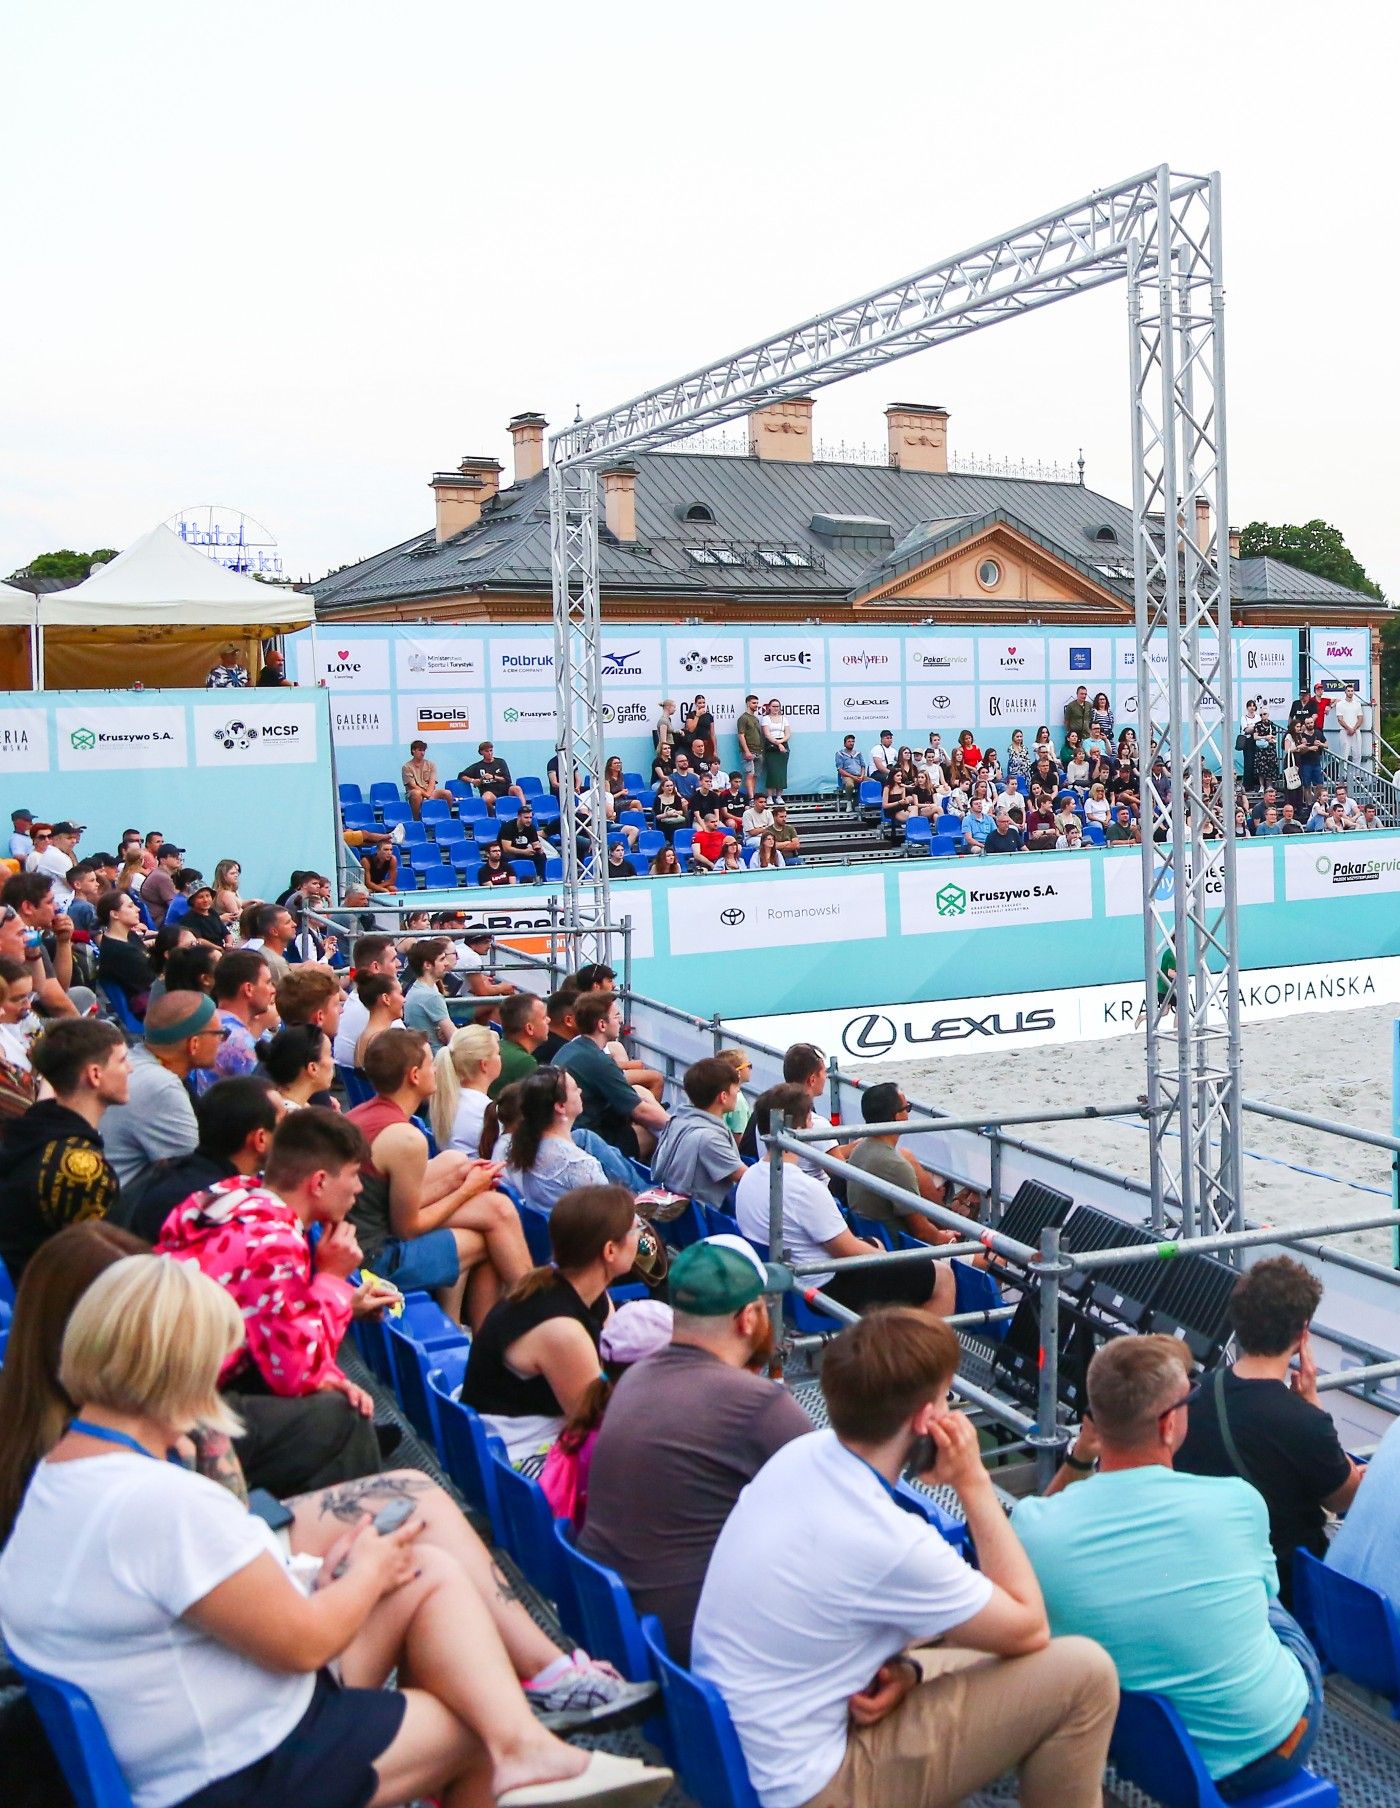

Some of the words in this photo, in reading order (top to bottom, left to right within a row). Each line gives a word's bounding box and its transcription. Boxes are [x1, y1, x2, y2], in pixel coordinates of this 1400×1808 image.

[502, 655, 554, 667] Polbruk
[710, 655, 734, 663] MCSP
[763, 653, 797, 662] arcus
[1260, 653, 1285, 662] GALERIA
[617, 704, 647, 714] caffe
[706, 703, 736, 715] ALERIA
[1006, 698, 1037, 709] GALERIA
[419, 708, 467, 720] Boels
[520, 710, 552, 719] Kruszywo
[780, 704, 820, 716] YOCERA
[336, 713, 380, 725] GALERIA
[617, 713, 648, 724] grano
[261, 725, 300, 737] MCSP
[98, 733, 151, 744] Kruszywo
[152, 732, 174, 741] S.A.
[970, 888, 1031, 904] Kruszywo
[1032, 885, 1059, 898] S.A.
[767, 904, 841, 920] Romanowski
[904, 1008, 1056, 1044] LEXUS
